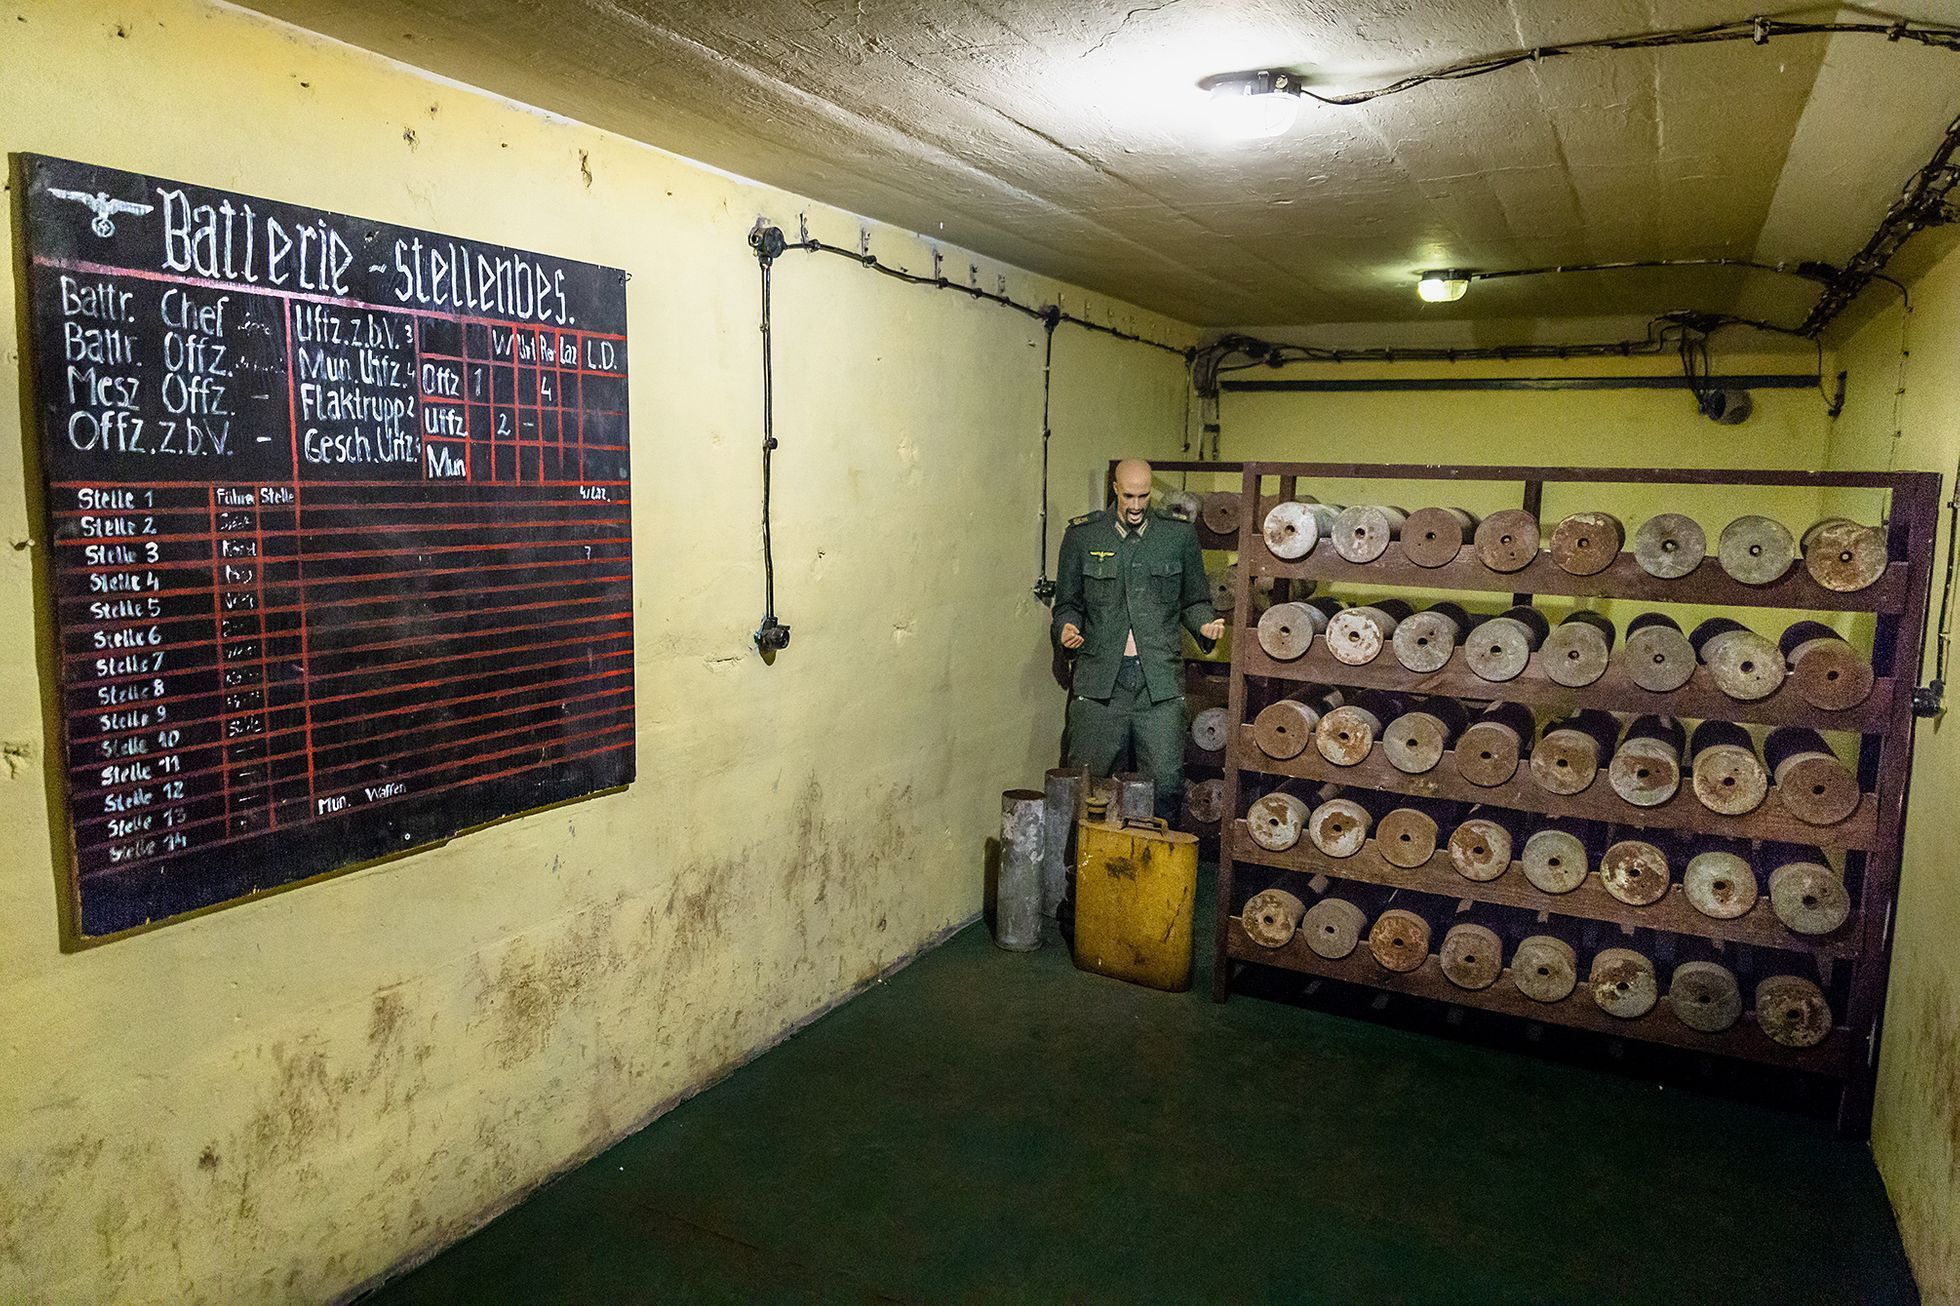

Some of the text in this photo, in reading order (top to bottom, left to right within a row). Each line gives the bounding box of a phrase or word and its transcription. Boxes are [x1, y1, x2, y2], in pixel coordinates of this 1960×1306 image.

[157, 187, 353, 296] Batterie
[60, 275, 134, 323] Battr.
[161, 288, 229, 337] Chef
[405, 324, 414, 344] 3
[587, 340, 618, 370] L.D.
[161, 372, 236, 417] Offz.
[541, 376, 552, 402] 4
[499, 413, 511, 436] 2
[77, 488, 153, 510] Stelle 1
[80, 515, 157, 538] Stelle 2
[85, 541, 159, 566] Stelle 3
[90, 570, 159, 593] Stelle 4
[90, 598, 161, 620] Stelle 5
[94, 625, 162, 650] Stelle 6
[96, 651, 165, 677] Stelle 7
[98, 678, 165, 705] Stelle 8
[100, 704, 166, 732] Stelle 9
[158, 730, 180, 747] 10
[101, 755, 180, 786] Stelle 11
[103, 781, 184, 812] Stelle 12
[318, 783, 407, 815] Mun. Waffen
[107, 815, 152, 838] Stelle
